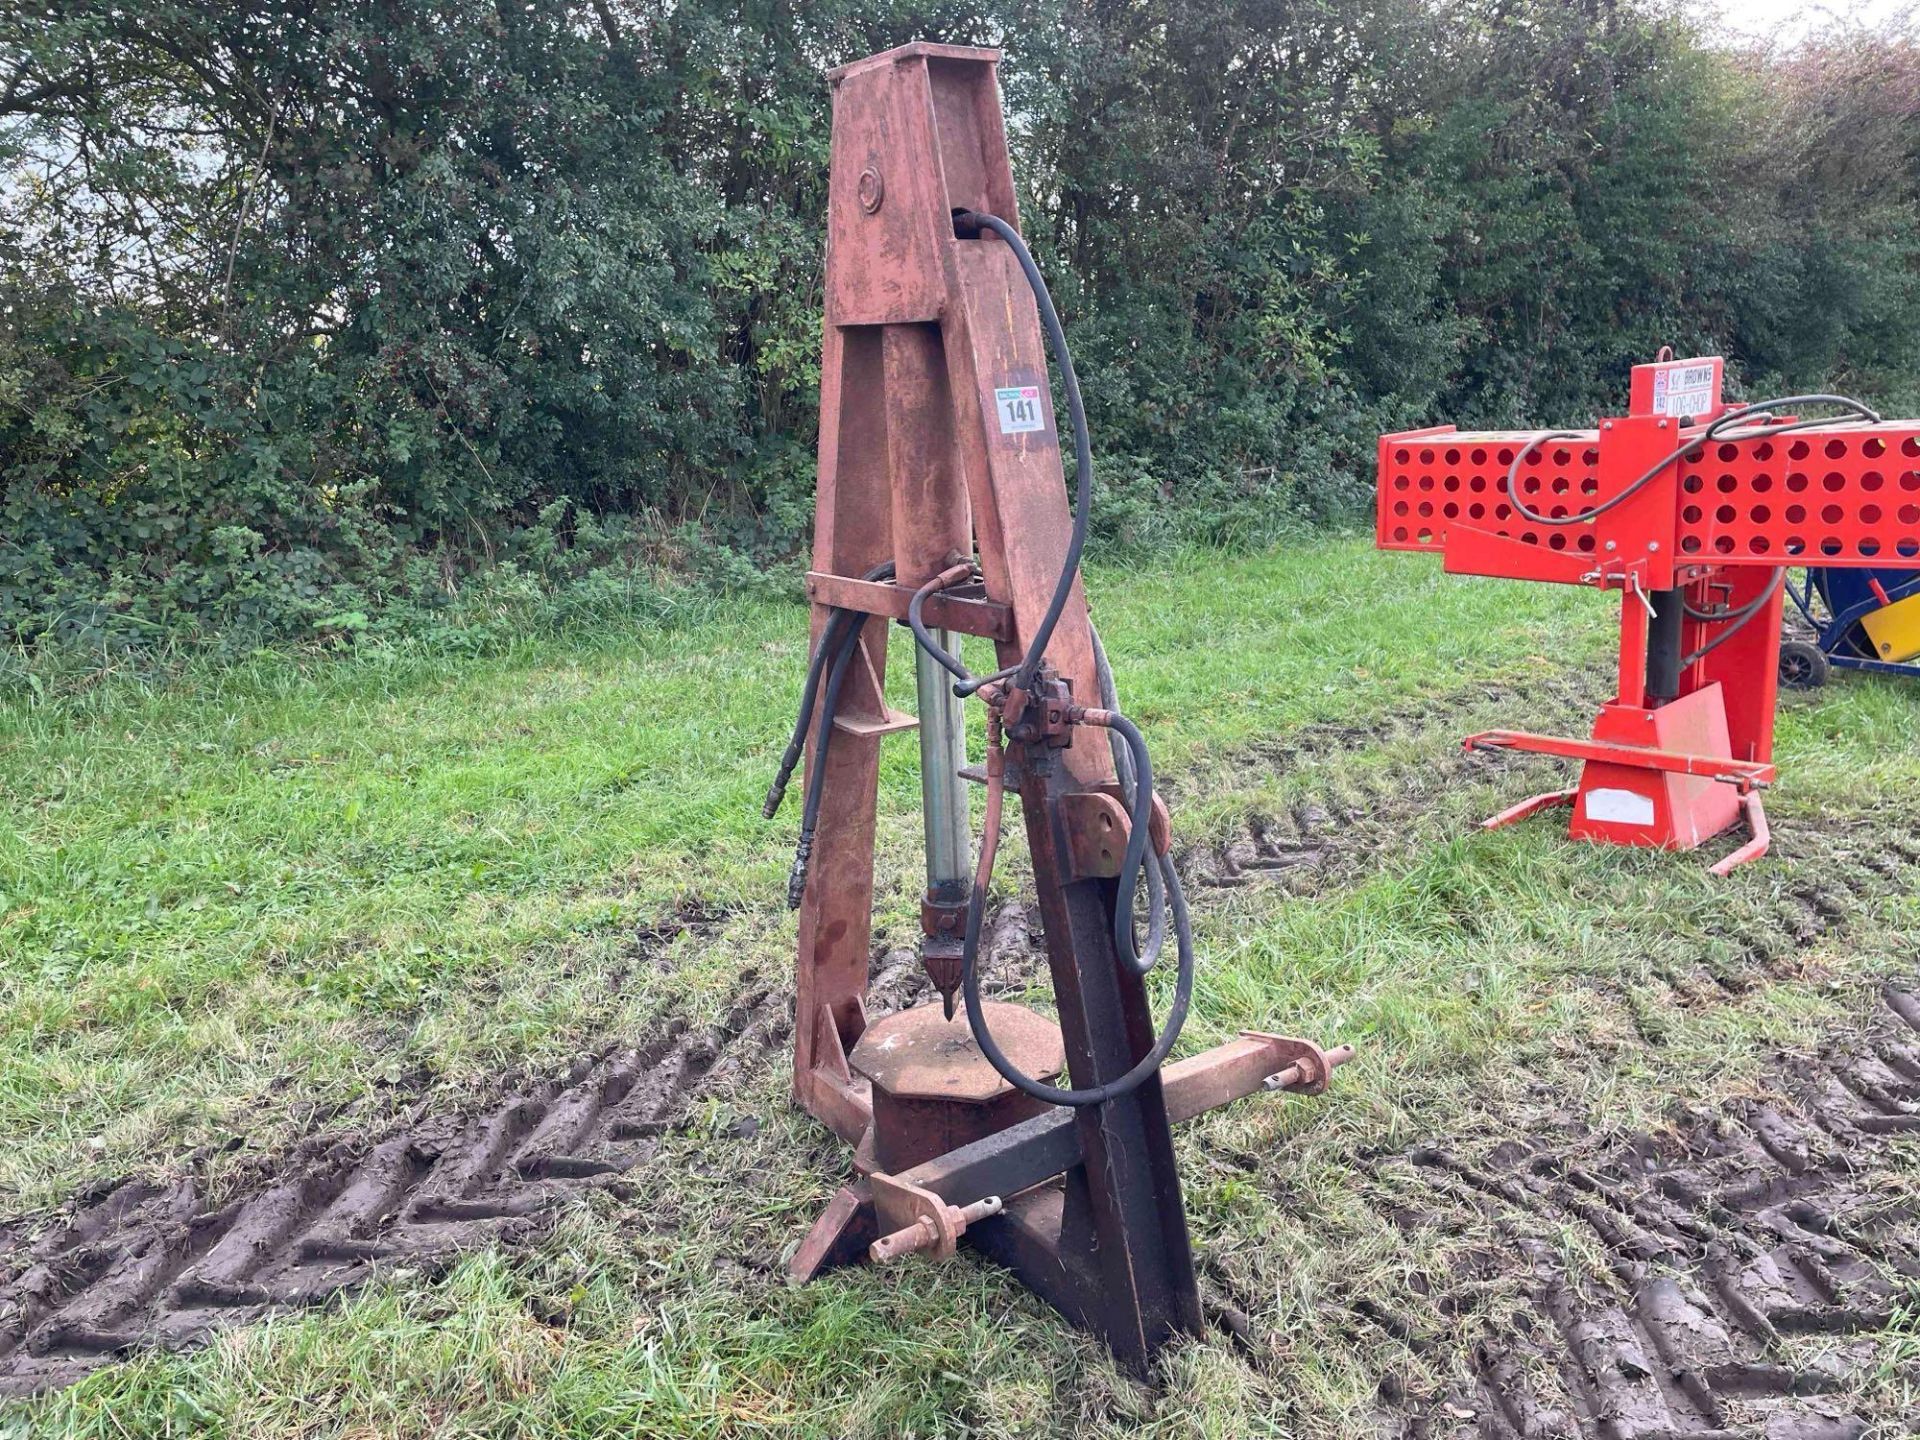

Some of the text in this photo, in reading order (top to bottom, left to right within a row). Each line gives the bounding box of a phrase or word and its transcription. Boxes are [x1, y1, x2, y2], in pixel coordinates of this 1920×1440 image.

[1684, 367, 1712, 385] BROWNS
[1006, 400, 1035, 422] 141
[1656, 396, 1666, 409] 142
